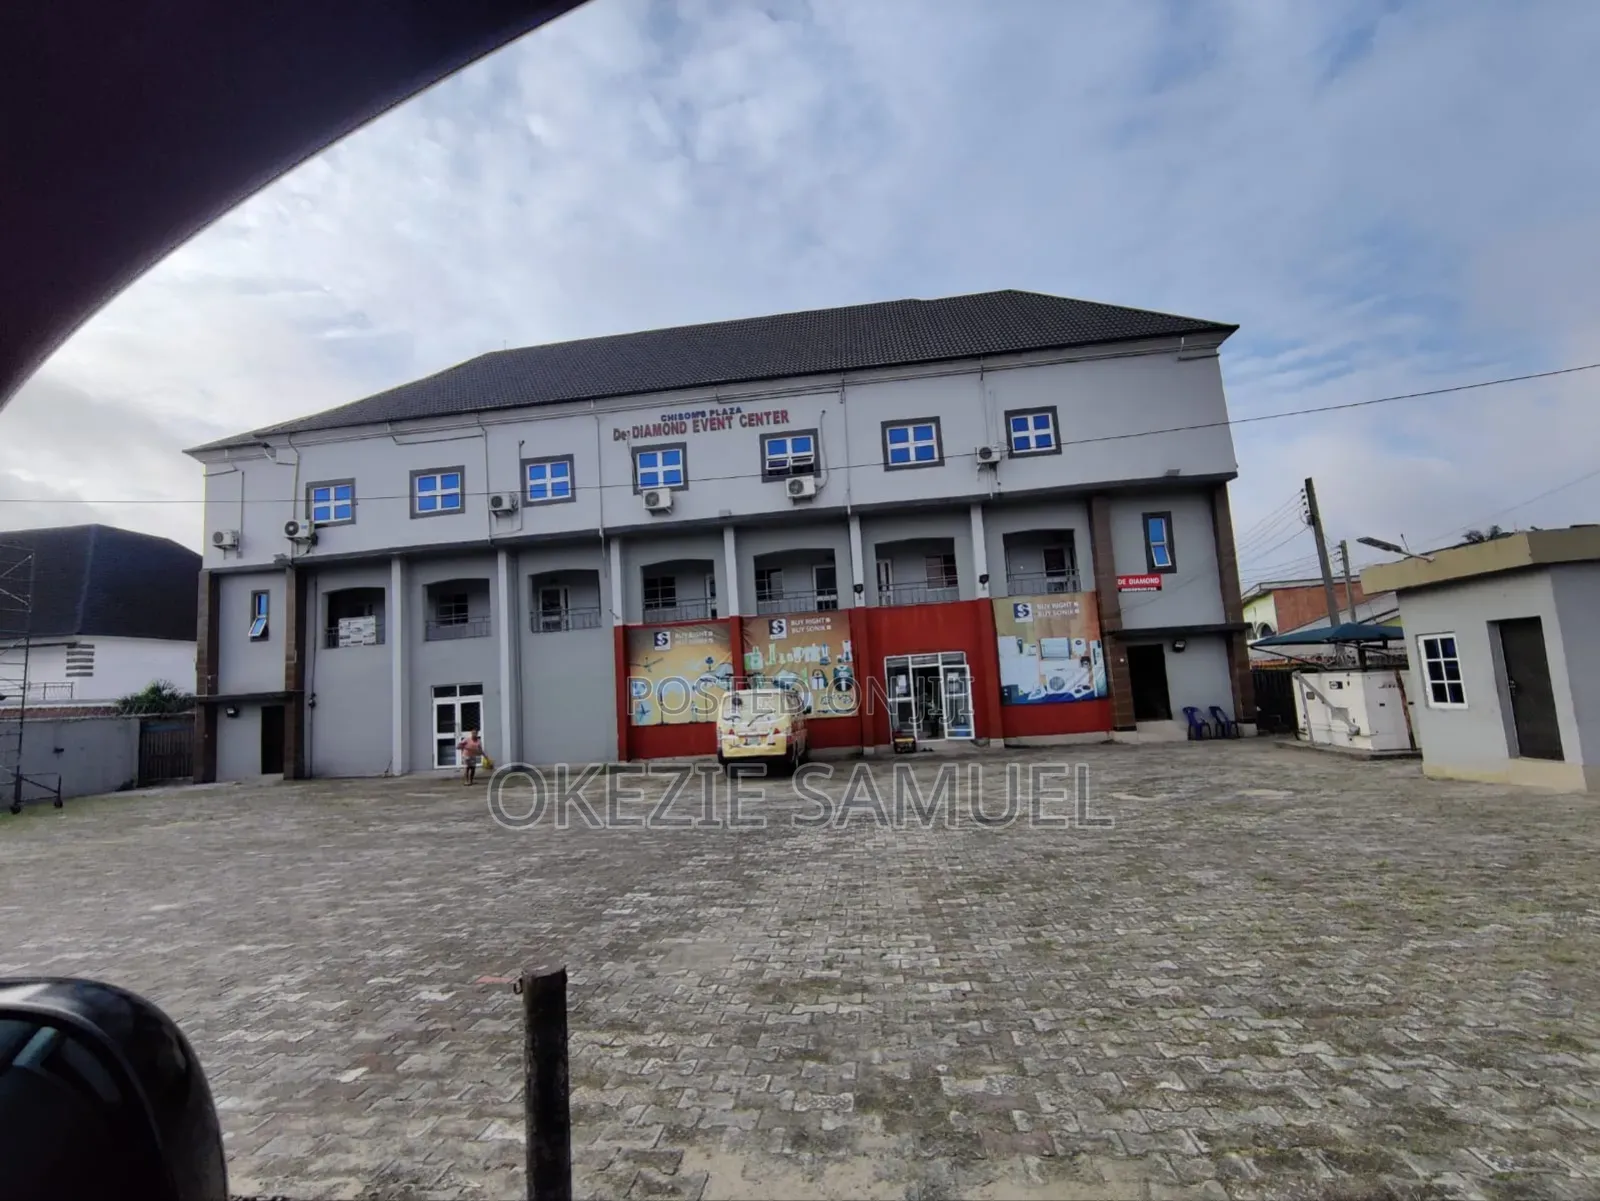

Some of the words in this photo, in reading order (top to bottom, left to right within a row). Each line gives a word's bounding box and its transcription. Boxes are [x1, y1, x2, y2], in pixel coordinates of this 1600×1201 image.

[709, 406, 742, 417] PLAZA
[632, 420, 687, 438] DIAMOND
[692, 415, 733, 433] EVENT
[739, 409, 789, 428] CENTER
[1128, 577, 1160, 585] DIAMOND
[791, 626, 804, 634] BUY
